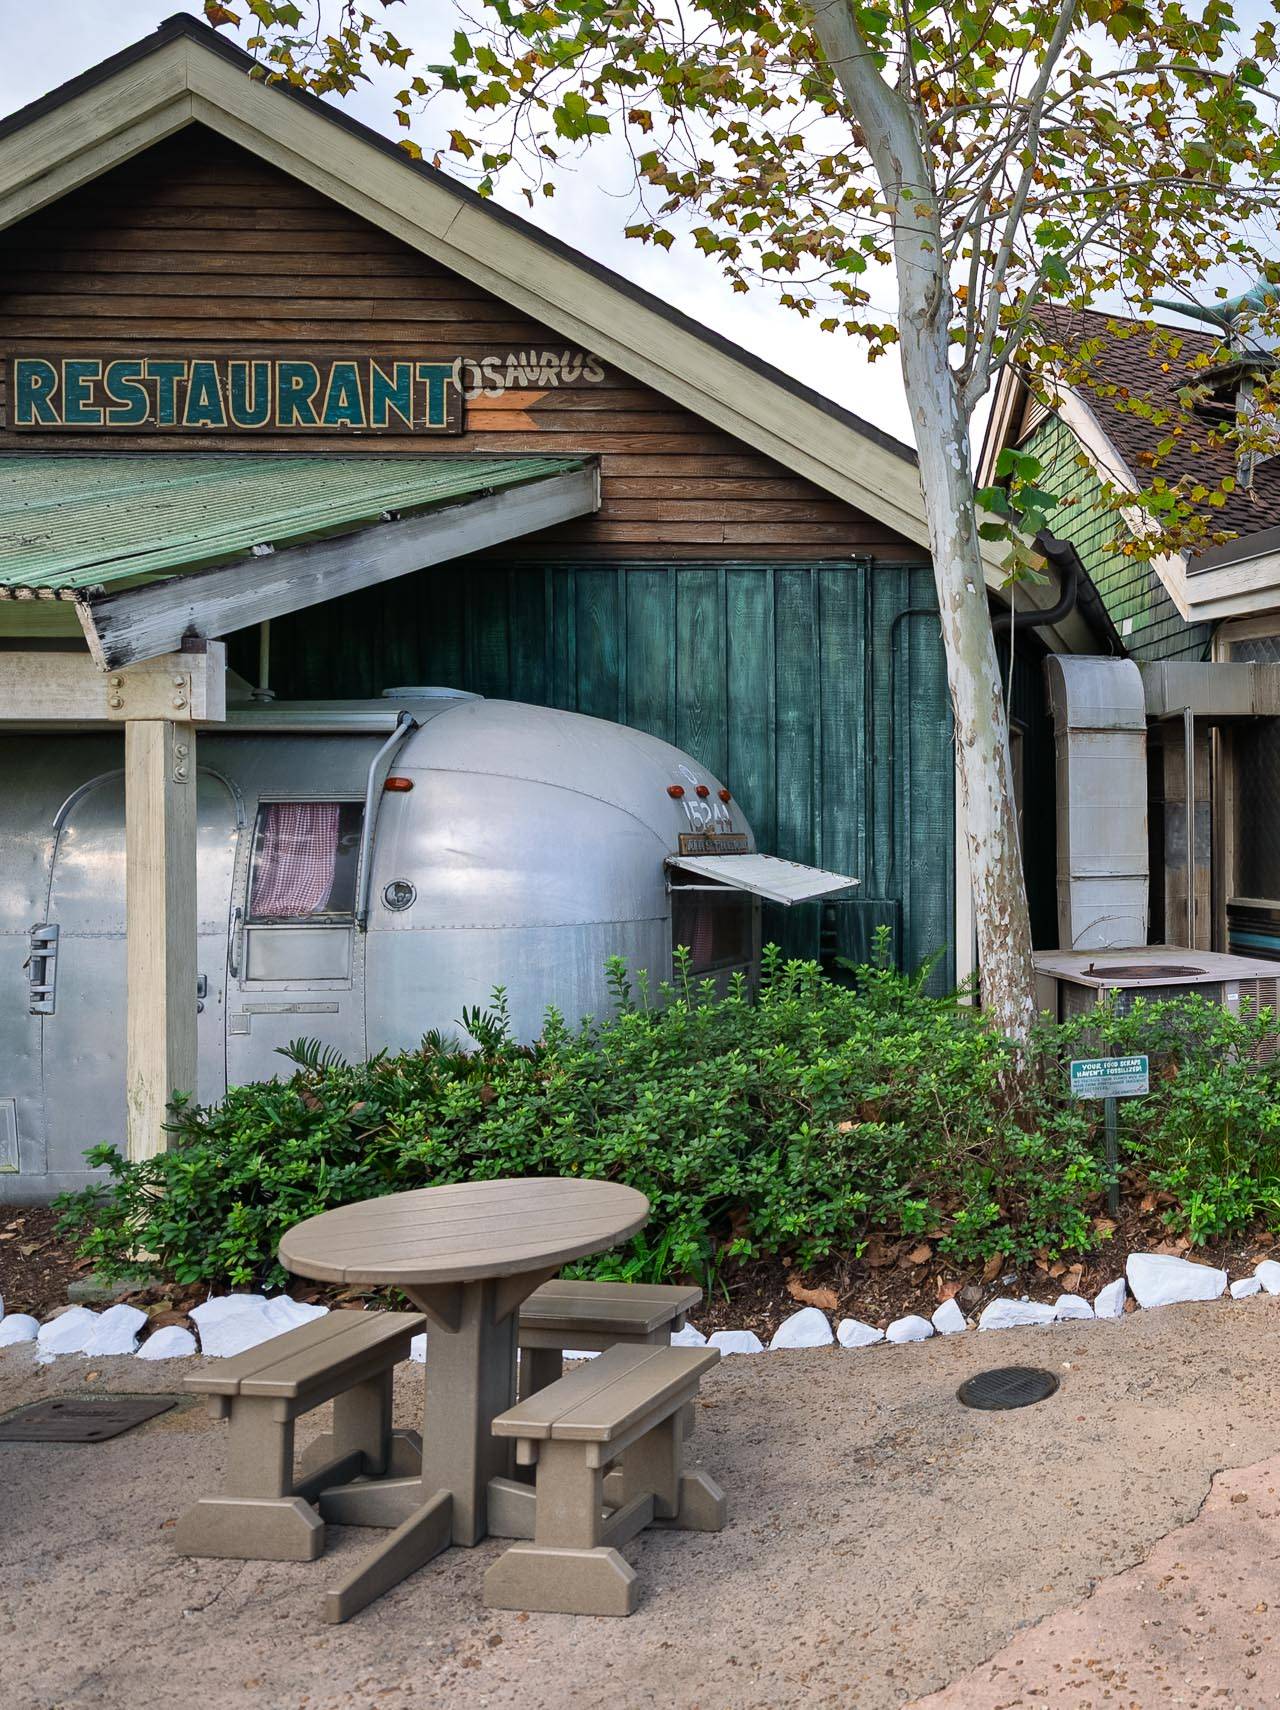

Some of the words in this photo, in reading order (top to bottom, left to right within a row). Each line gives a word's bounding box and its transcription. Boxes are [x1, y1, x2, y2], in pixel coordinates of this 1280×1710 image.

[14, 357, 454, 429] RESTAURANT
[452, 350, 605, 400] OSAURUS
[1077, 1069, 1103, 1077] HAVEN'T
